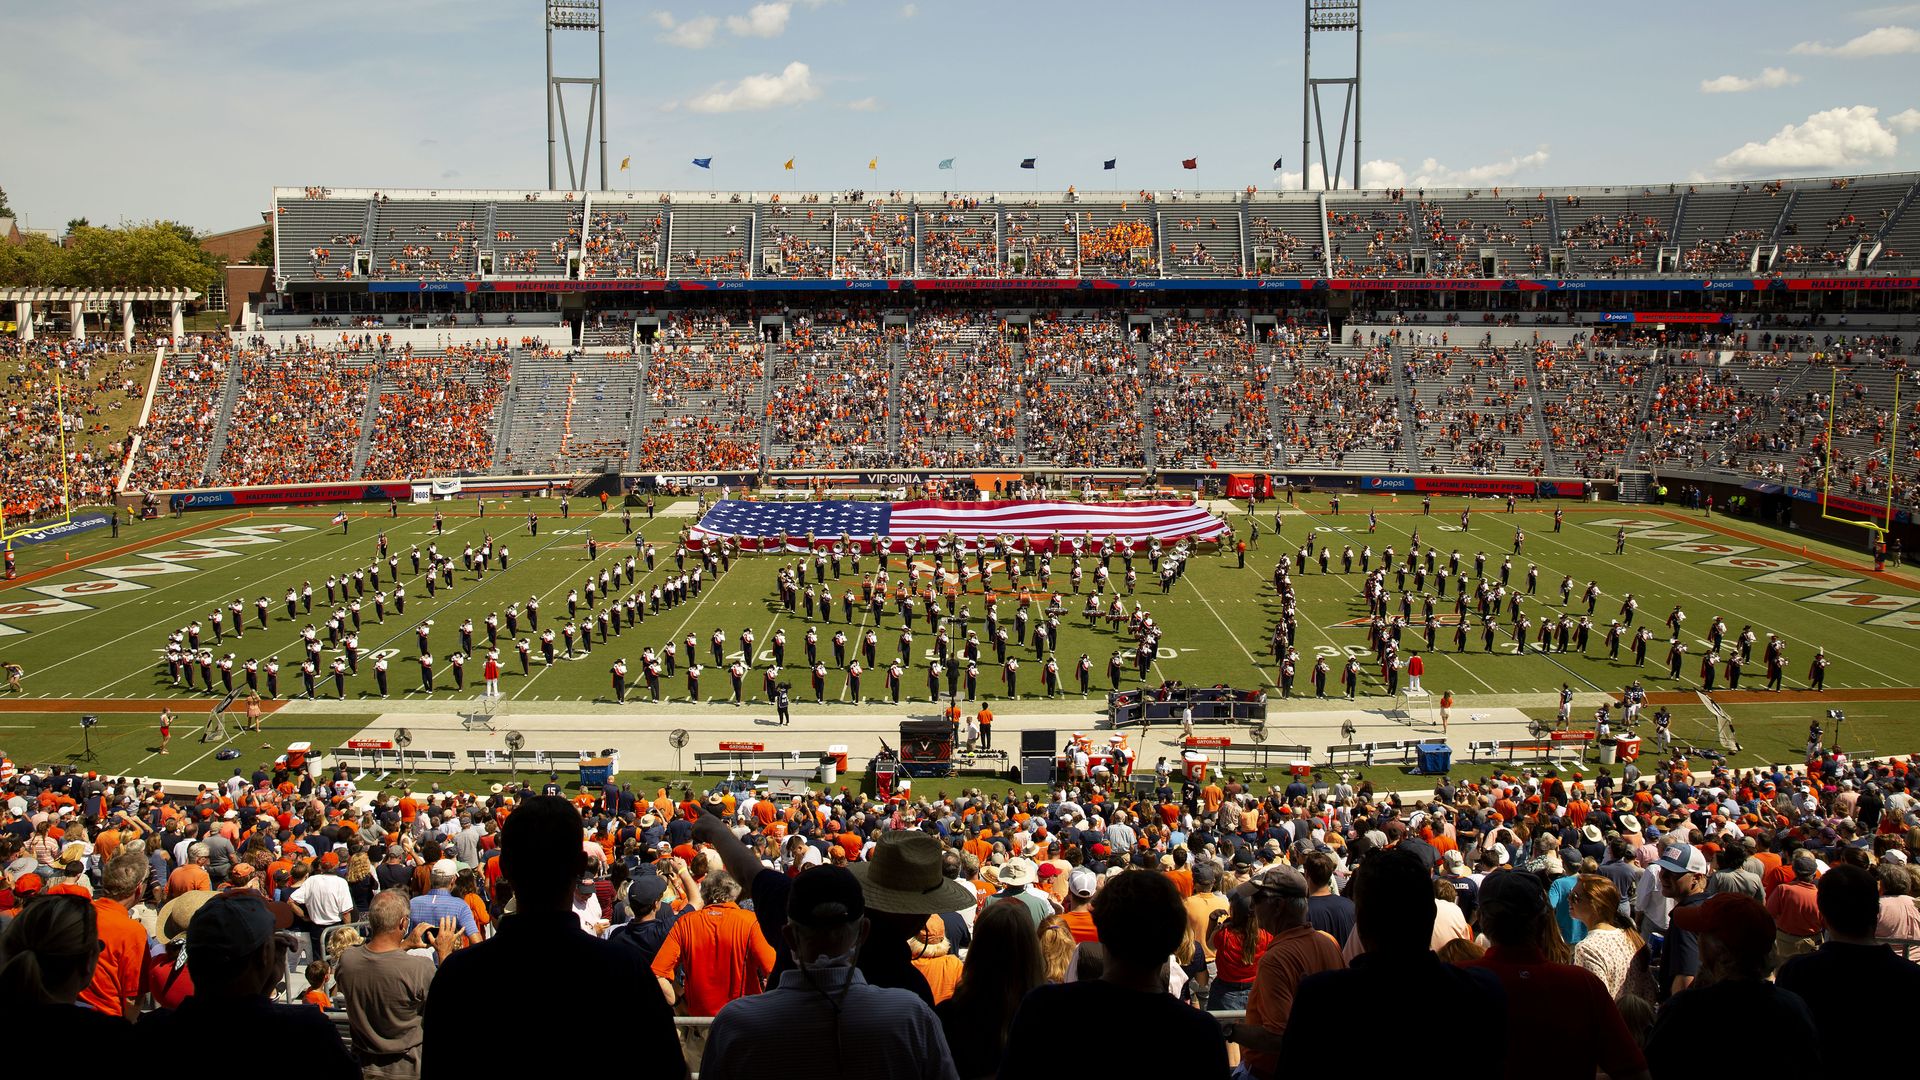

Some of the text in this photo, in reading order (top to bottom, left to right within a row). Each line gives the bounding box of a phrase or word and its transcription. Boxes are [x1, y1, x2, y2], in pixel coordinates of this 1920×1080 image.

[1350, 281, 1394, 289] HALFTIME
[1397, 281, 1432, 289] FUELED
[1434, 281, 1448, 289] BY
[1566, 281, 1586, 289] pepsi
[1713, 281, 1734, 289] pepsi
[1811, 280, 1865, 289] HALFTIME
[1869, 279, 1912, 288] FUELED
[867, 473, 922, 484] VIRGINIA
[1383, 479, 1405, 488] pepsi
[197, 494, 222, 504] pepsi
[1313, 645, 1373, 657] 30
[547, 786, 557, 797] 15
